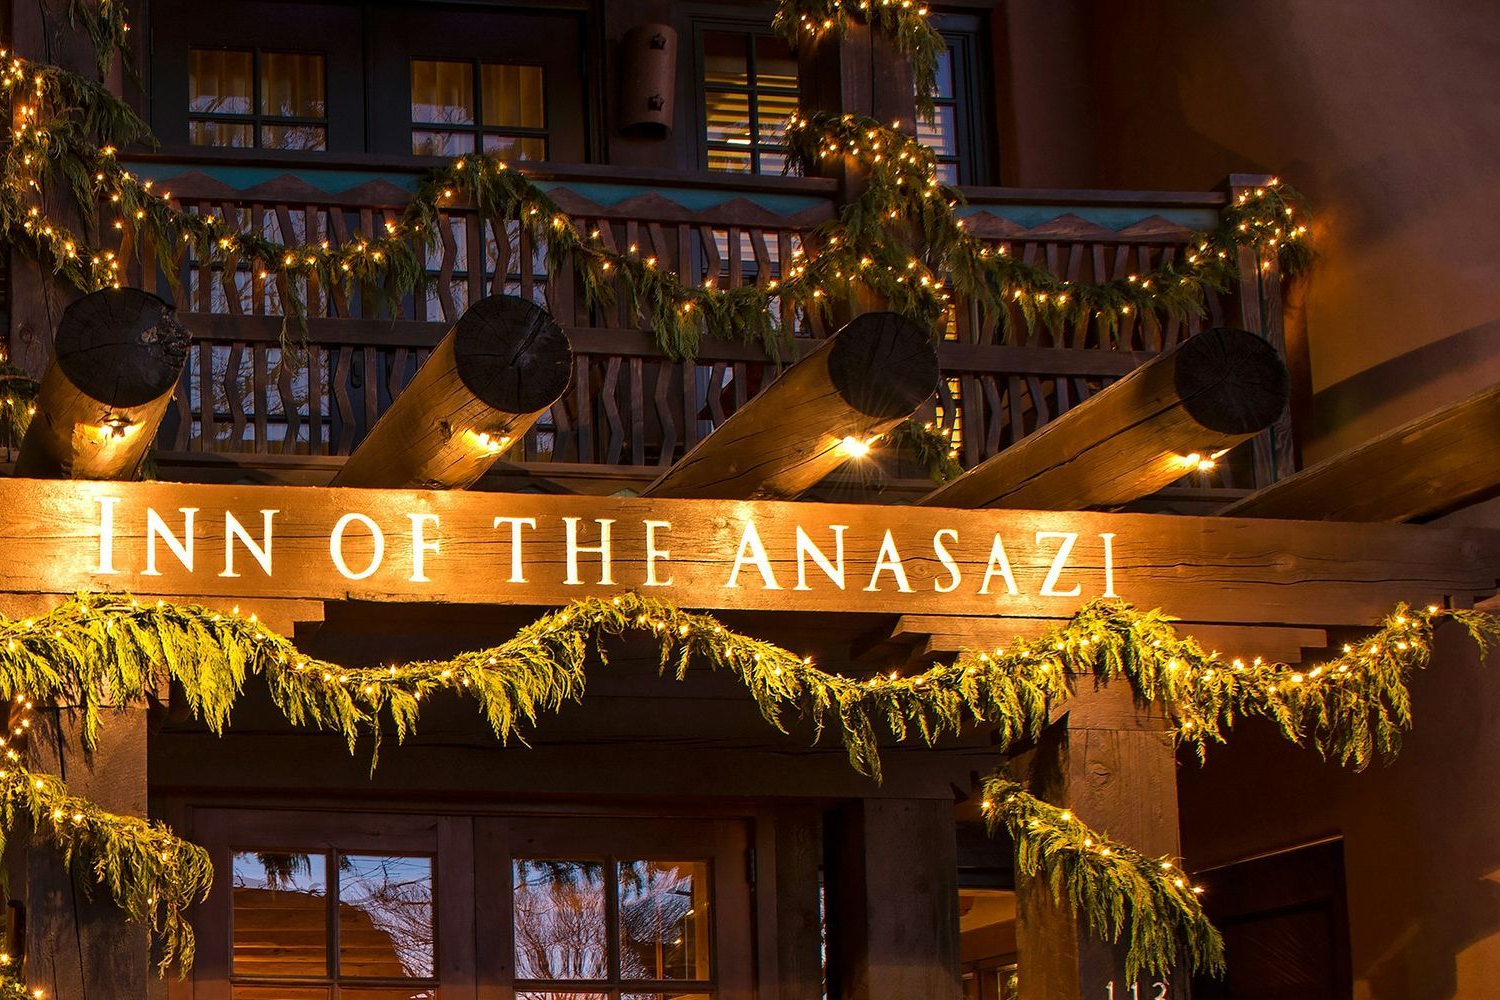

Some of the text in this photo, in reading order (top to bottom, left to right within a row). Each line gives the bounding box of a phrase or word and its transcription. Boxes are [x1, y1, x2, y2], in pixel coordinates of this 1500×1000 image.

[92, 496, 1117, 599] INN OF THE ANASAZI
